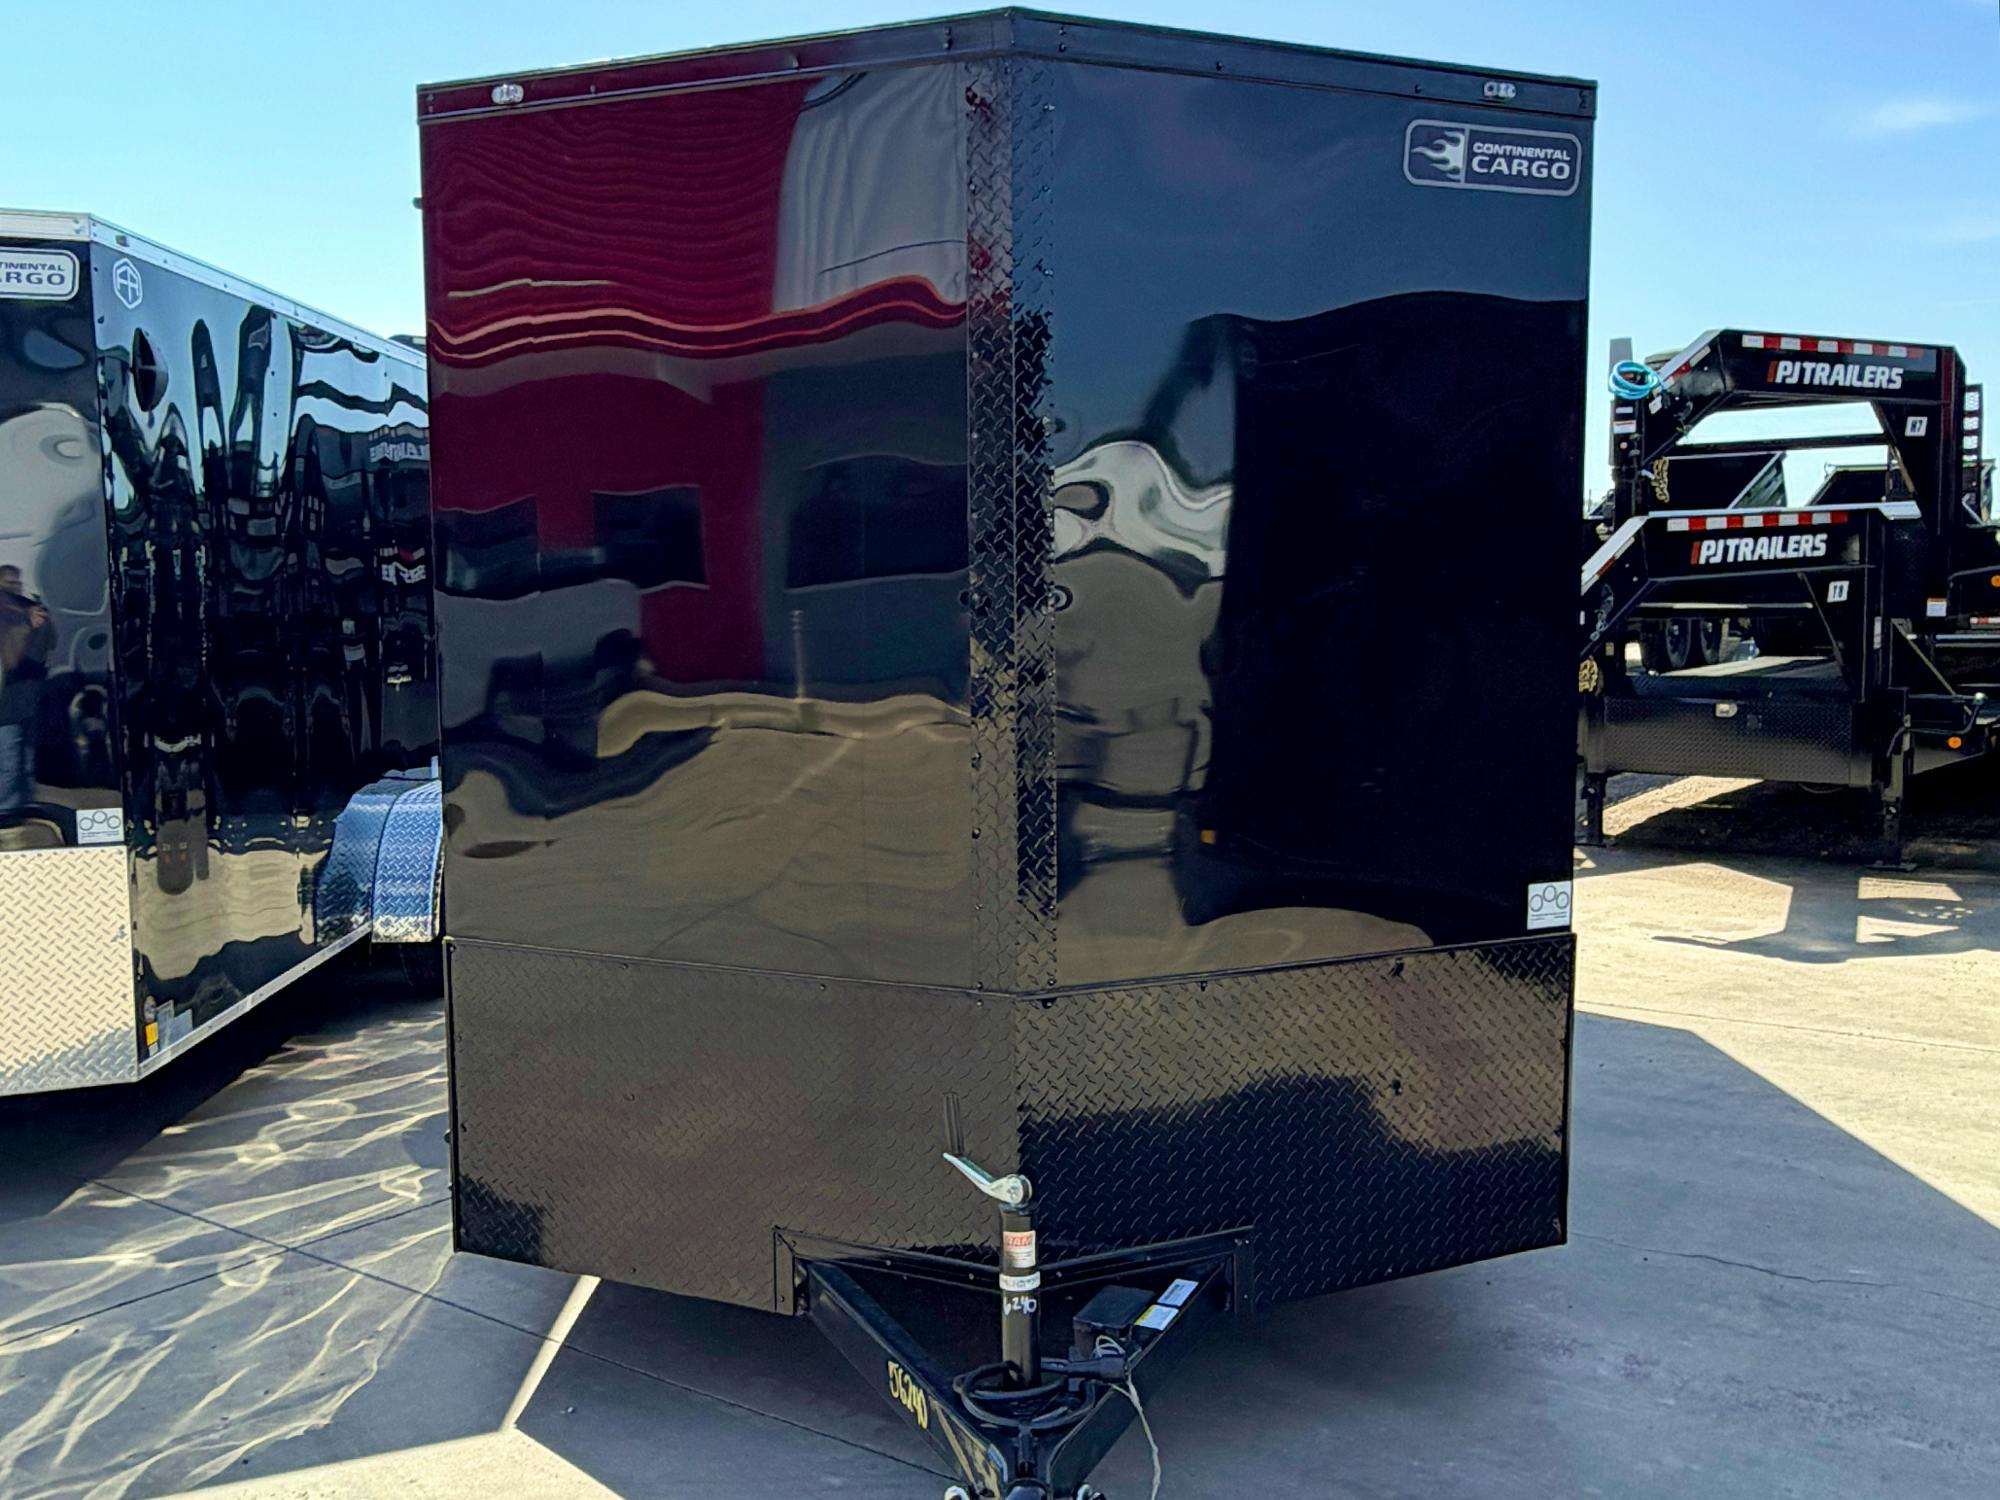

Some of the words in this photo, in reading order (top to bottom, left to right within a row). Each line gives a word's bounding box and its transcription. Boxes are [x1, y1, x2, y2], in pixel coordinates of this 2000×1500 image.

[1473, 141, 1571, 161] CONTINENTAL
[1471, 155, 1571, 179] CARGO
[0, 271, 66, 286] RGO
[1775, 360, 1800, 384] PJ
[1802, 361, 1904, 389] TRAILERS
[1698, 539, 1725, 565] PJ
[1726, 533, 1828, 563] TRAILERS
[1003, 1295, 1037, 1316] 6240
